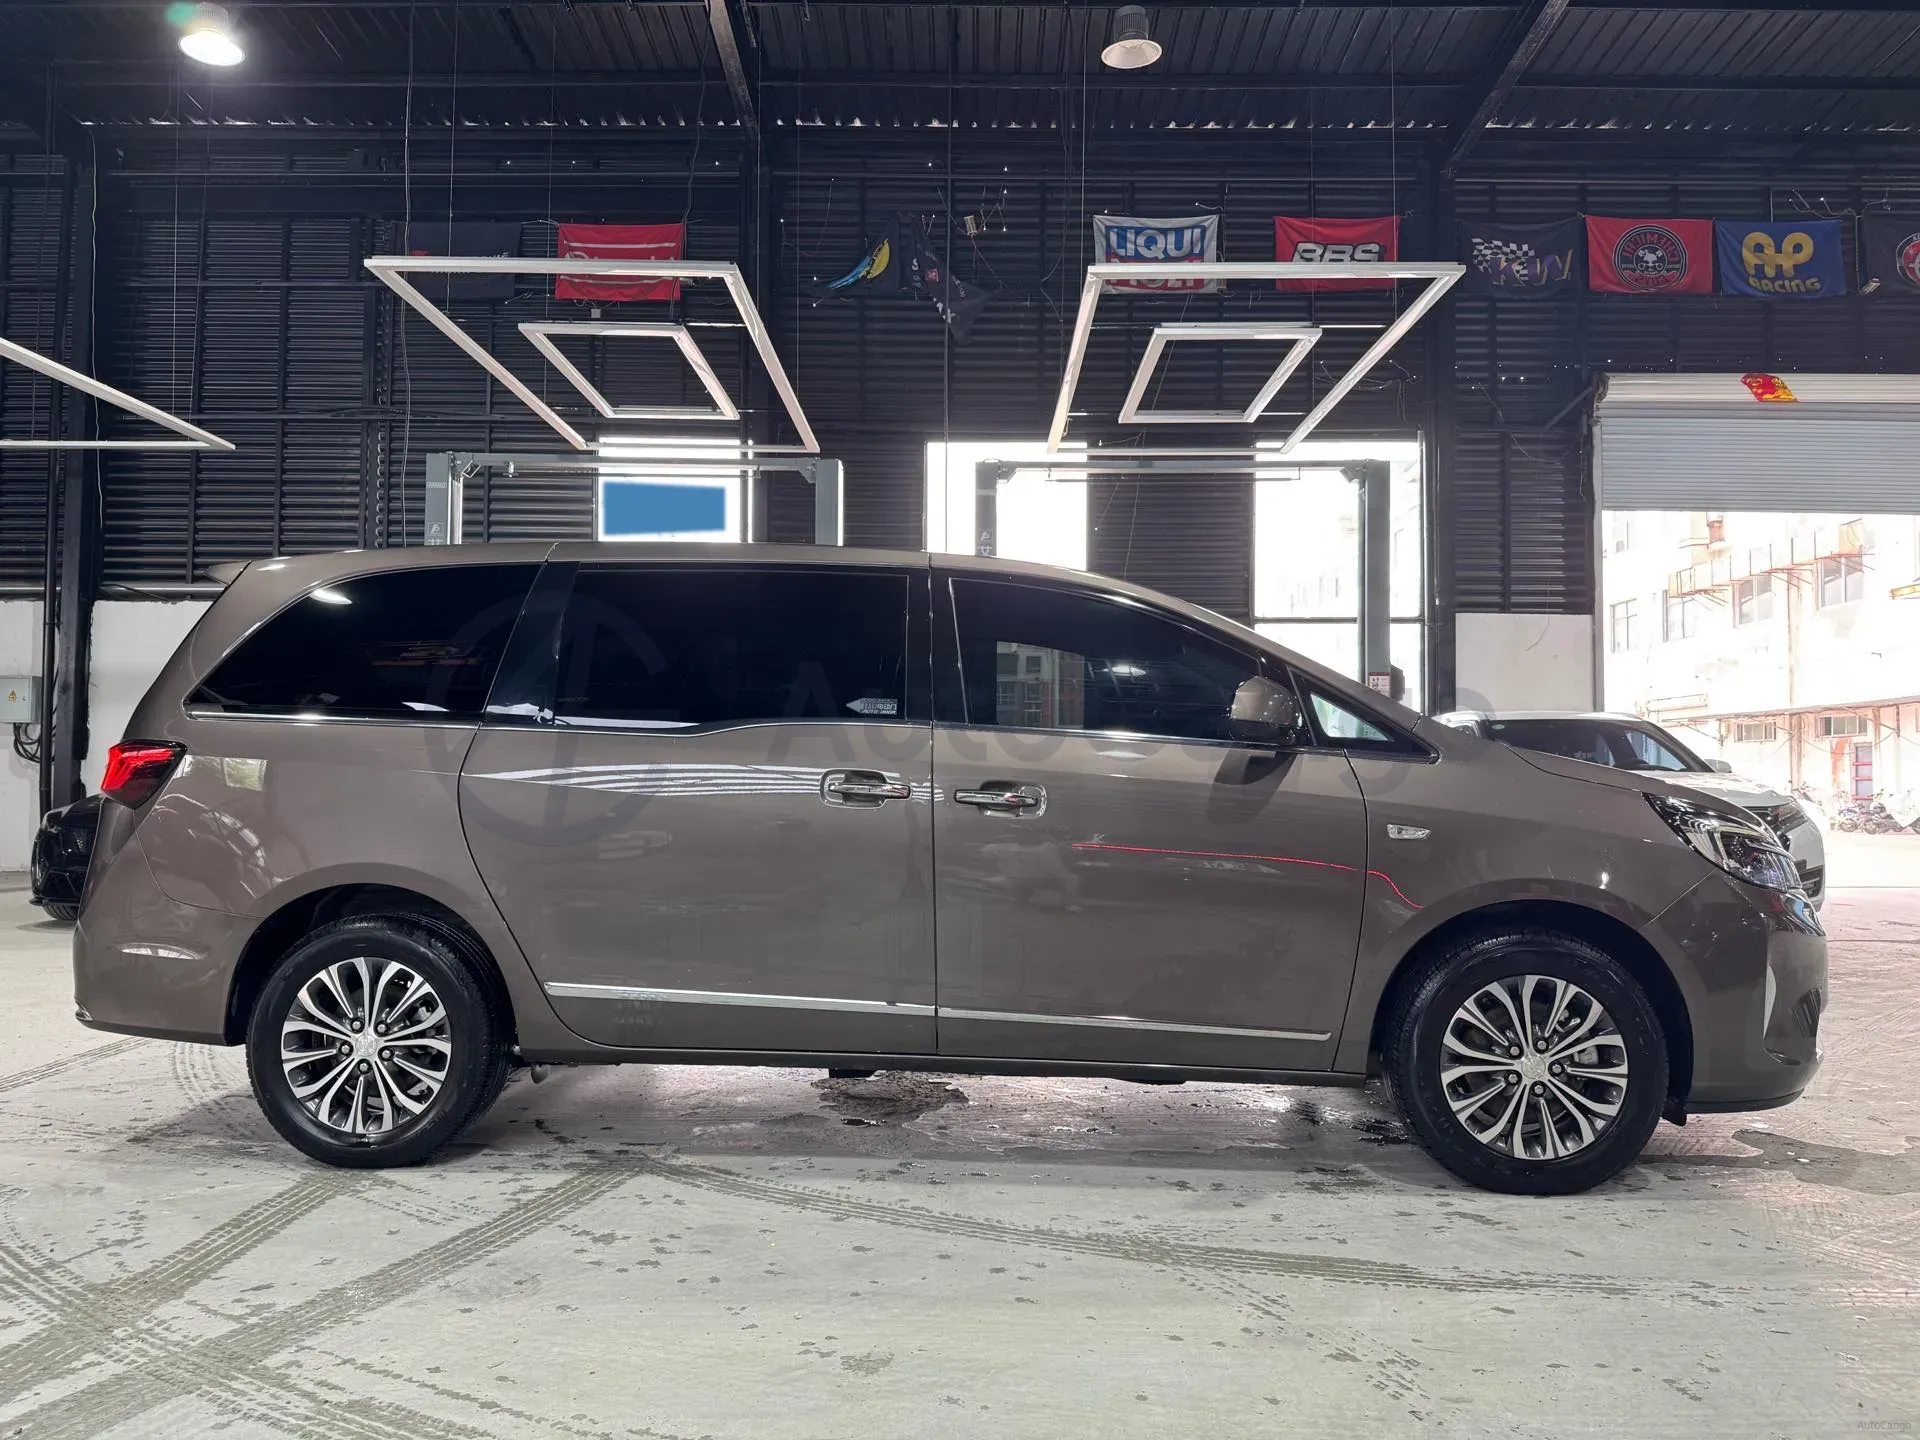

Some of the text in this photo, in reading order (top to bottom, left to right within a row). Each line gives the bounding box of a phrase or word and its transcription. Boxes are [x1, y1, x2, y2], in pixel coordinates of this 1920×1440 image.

[1109, 228, 1202, 260] LIQUI
[1292, 242, 1382, 263] BBS
[1742, 231, 1815, 277] AP
